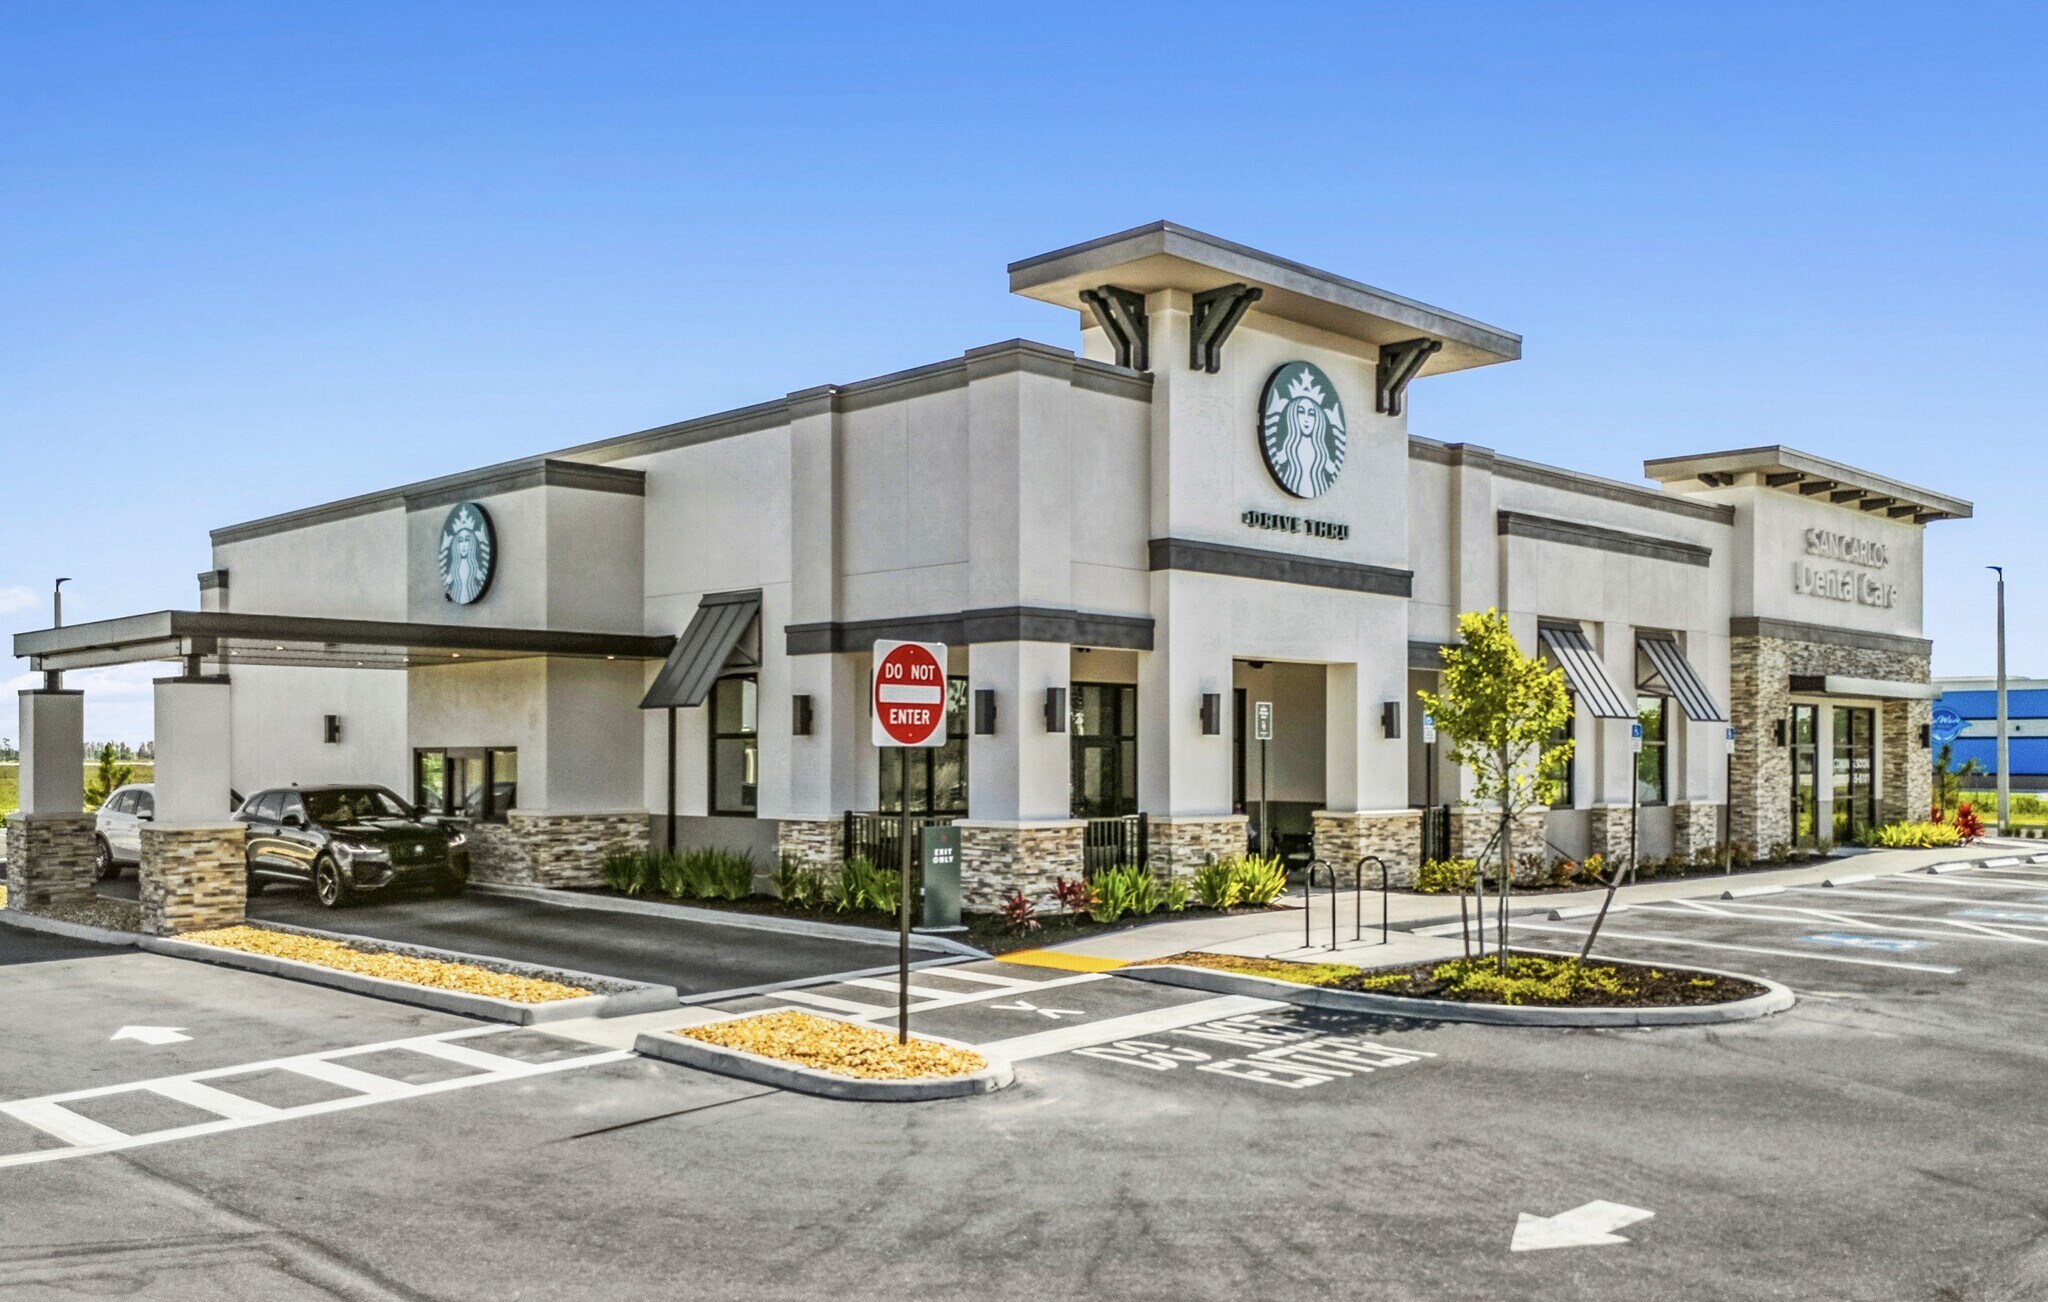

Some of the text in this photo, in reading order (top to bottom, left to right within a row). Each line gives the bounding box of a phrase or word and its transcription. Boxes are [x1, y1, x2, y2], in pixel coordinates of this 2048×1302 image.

[1247, 510, 1350, 541] DRIVE THRU
[1805, 527, 1839, 559] SAN
[1796, 560, 1899, 608] Dental Care
[885, 662, 936, 681] DO NOT
[889, 707, 931, 726] ENTER
[932, 856, 955, 864] ONLY
[934, 847, 953, 857] EXIT
[1071, 1040, 1212, 1071] DO
[1195, 1036, 1438, 1089] ENTER
